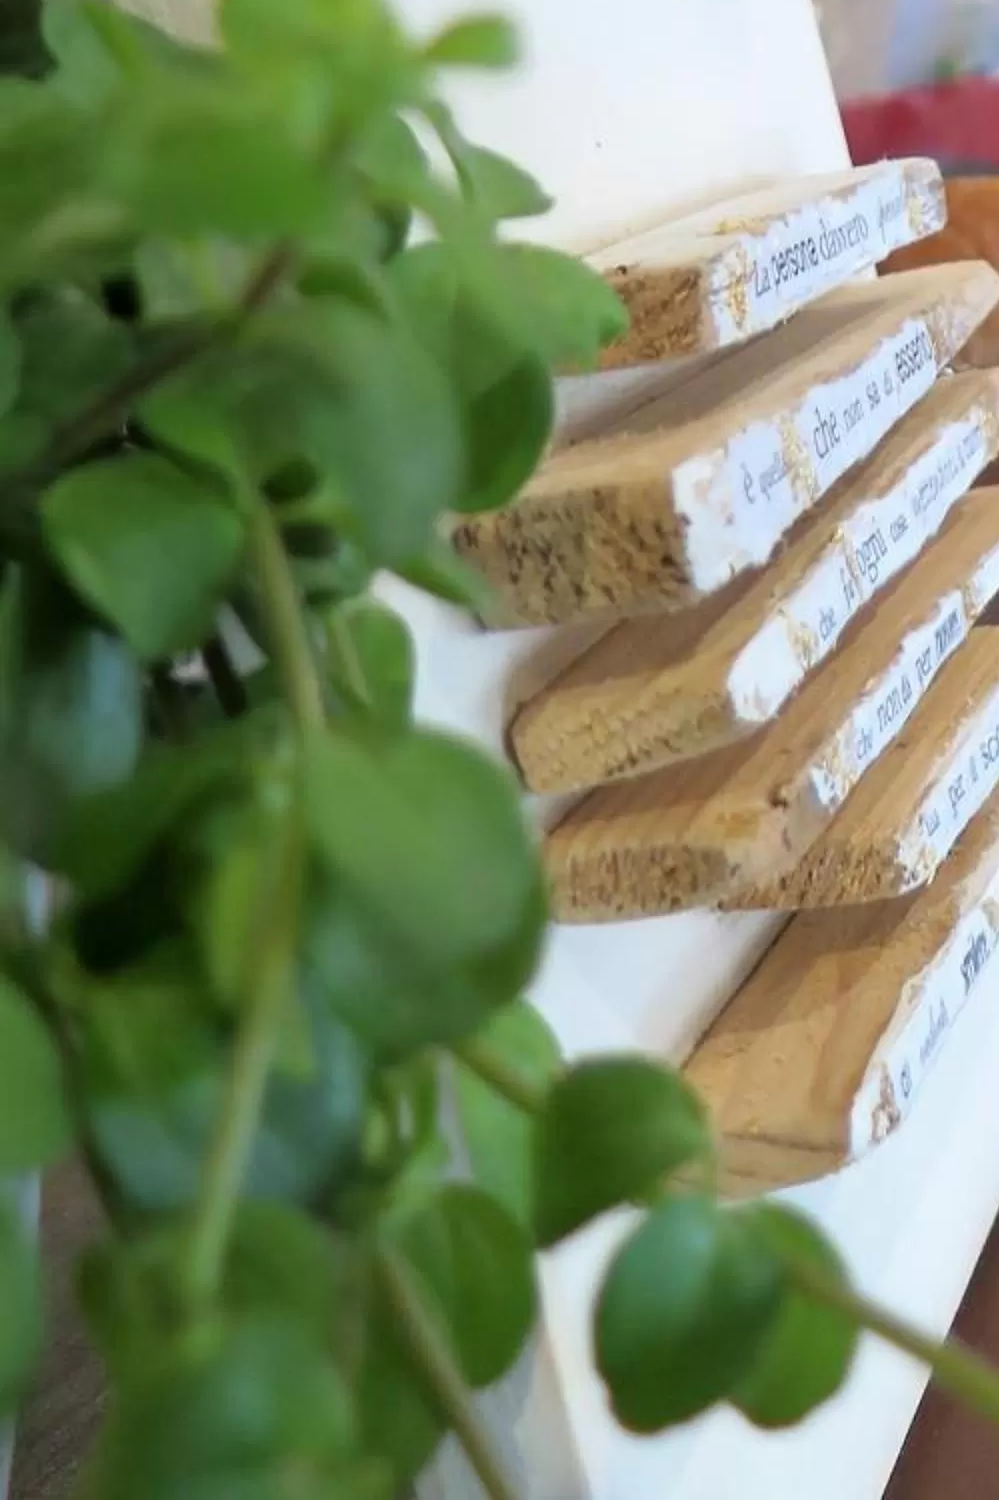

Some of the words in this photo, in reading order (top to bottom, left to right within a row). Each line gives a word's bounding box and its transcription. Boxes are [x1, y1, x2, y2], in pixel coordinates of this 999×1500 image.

[753, 259, 771, 298] La
[772, 236, 819, 297] persona
[813, 405, 840, 460] che
[855, 516, 888, 583] ogni
[948, 772, 966, 820] per
